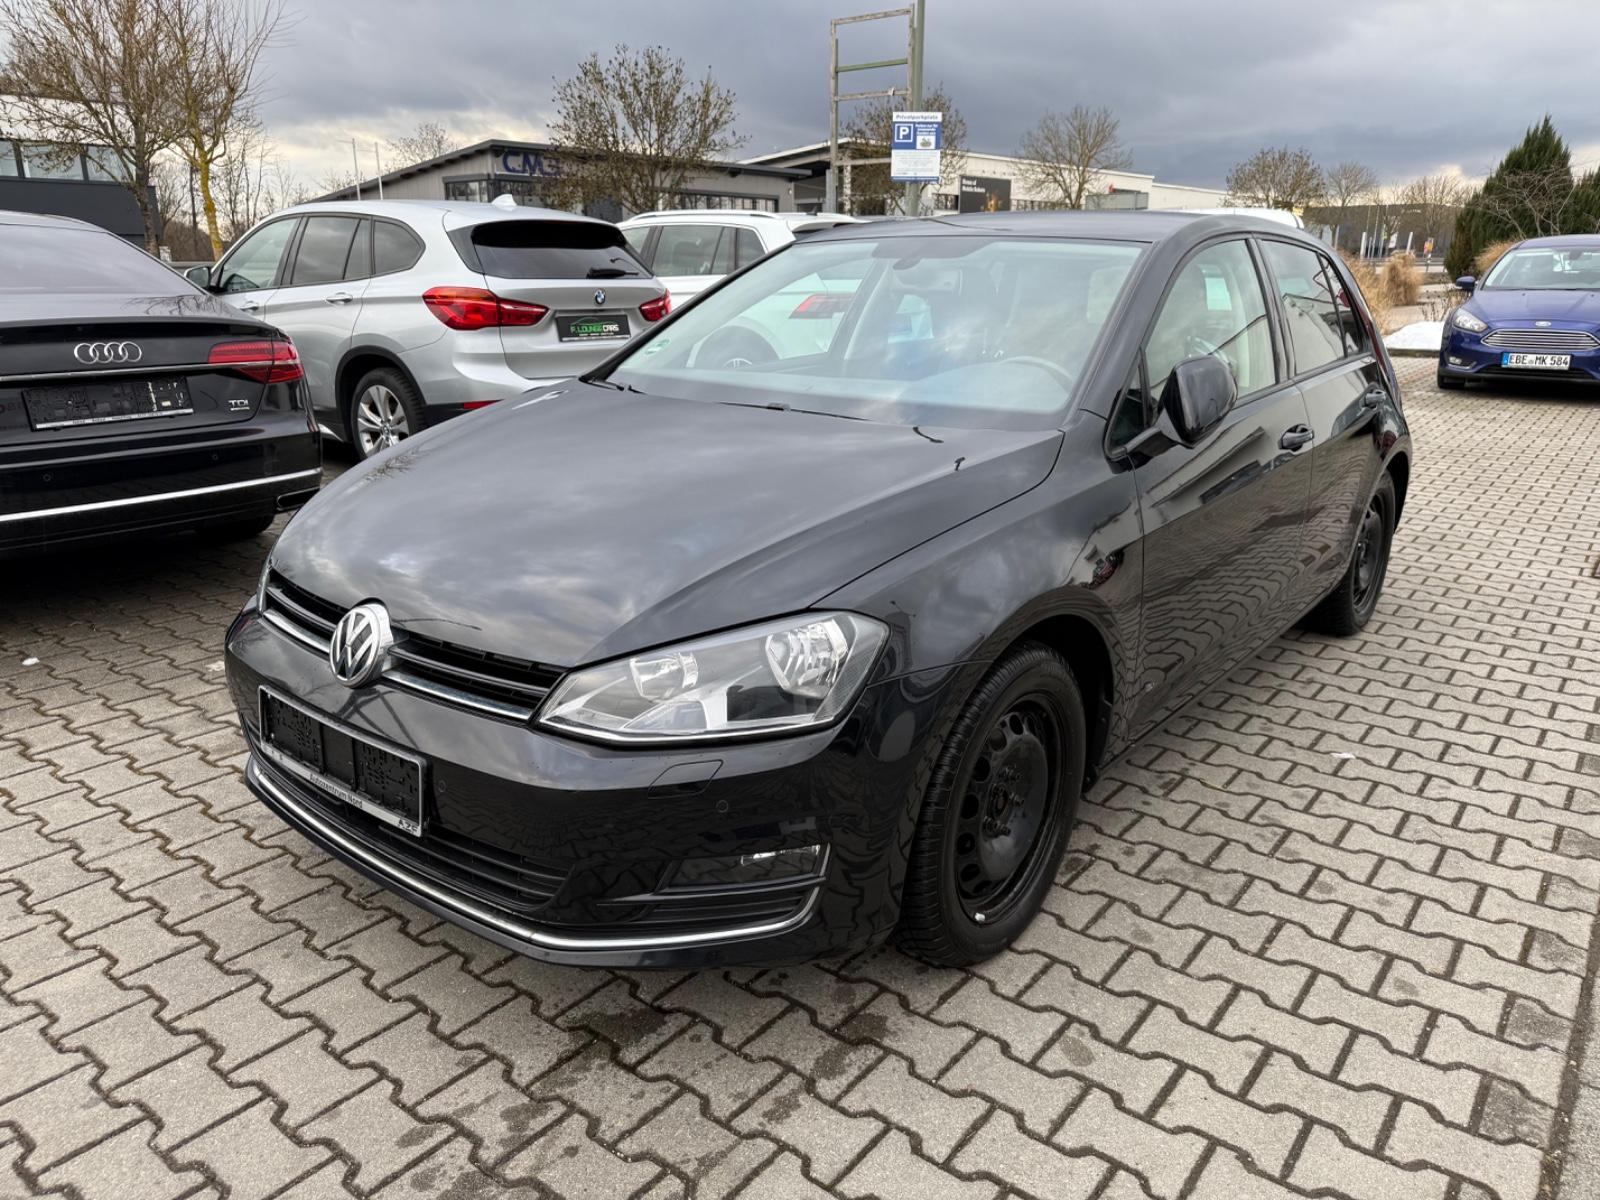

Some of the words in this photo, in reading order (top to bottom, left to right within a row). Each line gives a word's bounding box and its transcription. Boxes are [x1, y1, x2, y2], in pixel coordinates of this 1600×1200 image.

[899, 126, 909, 139] P
[1509, 355, 1528, 365] EBE
[1535, 355, 1548, 365] MK
[1550, 356, 1569, 366] 584
[228, 399, 249, 407] TDI
[309, 774, 347, 801] Autozentrum
[347, 793, 363, 808] Nord
